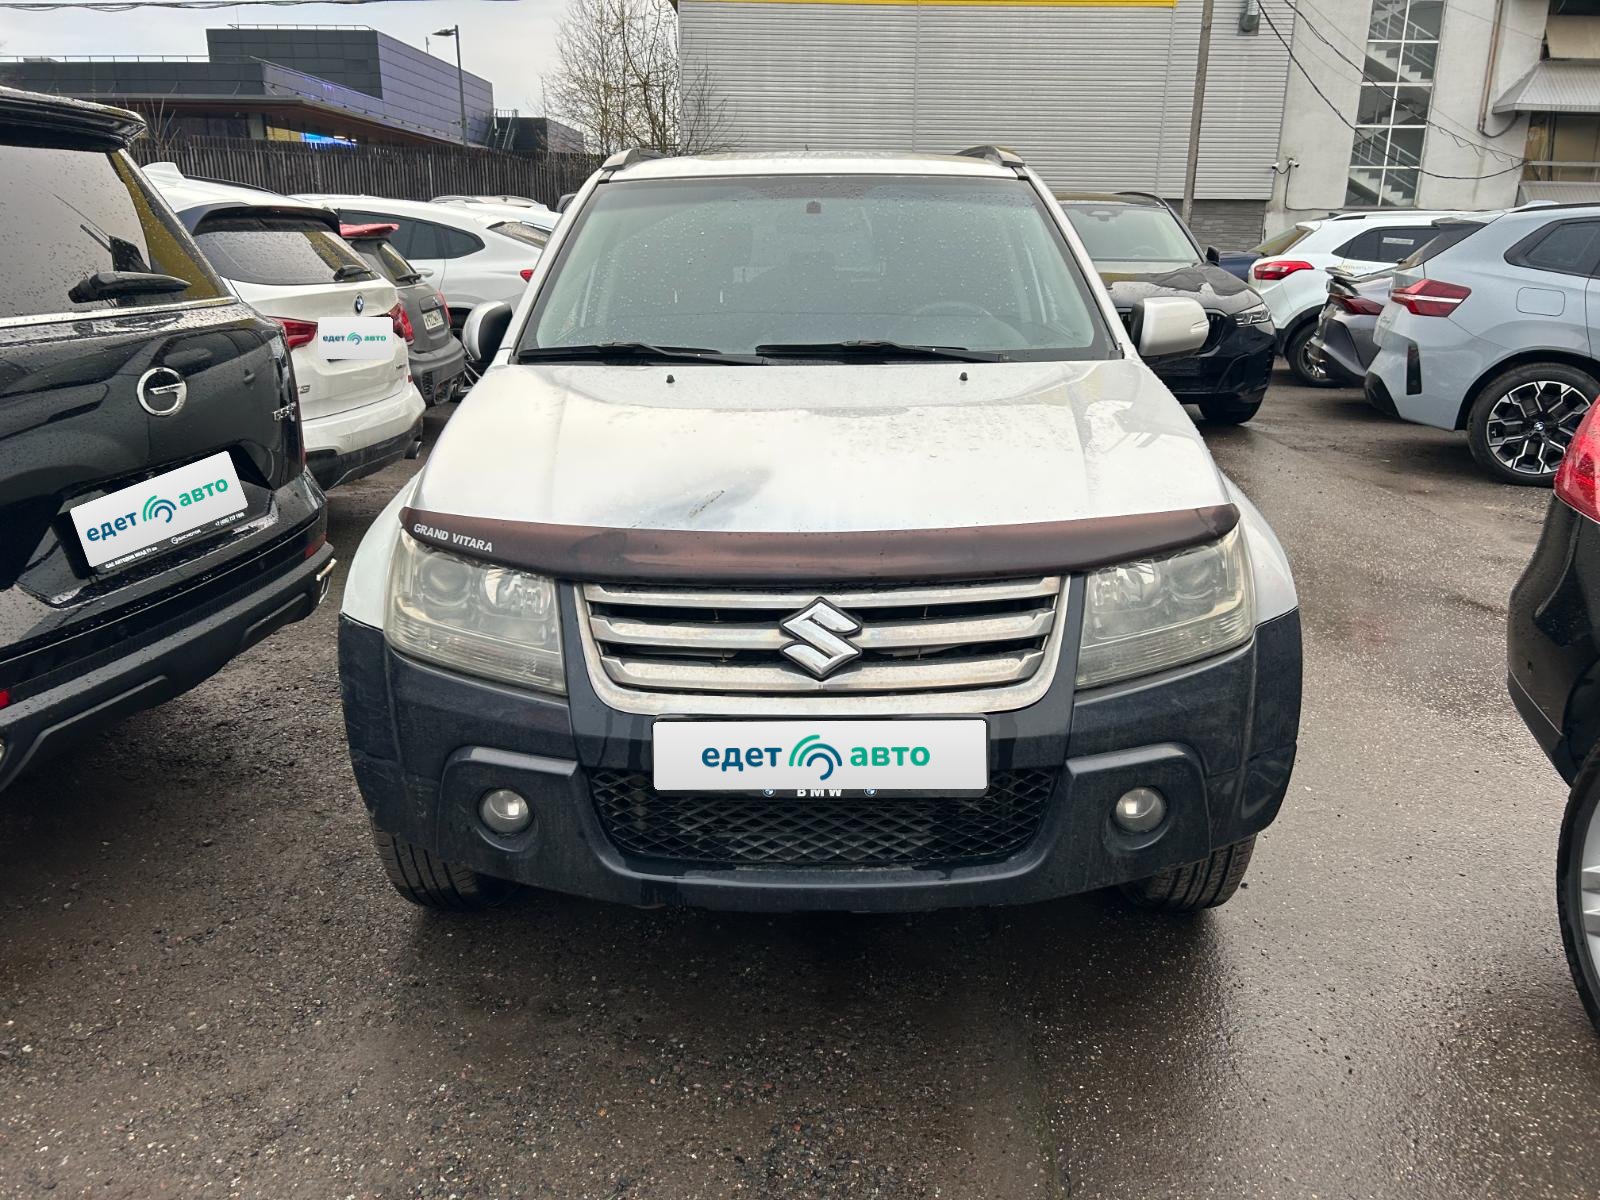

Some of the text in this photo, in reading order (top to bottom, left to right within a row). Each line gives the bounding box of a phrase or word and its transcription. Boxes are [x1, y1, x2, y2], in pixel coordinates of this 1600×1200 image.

[413, 523, 493, 552] GRAND VITARA
[796, 789, 842, 797] BMW
